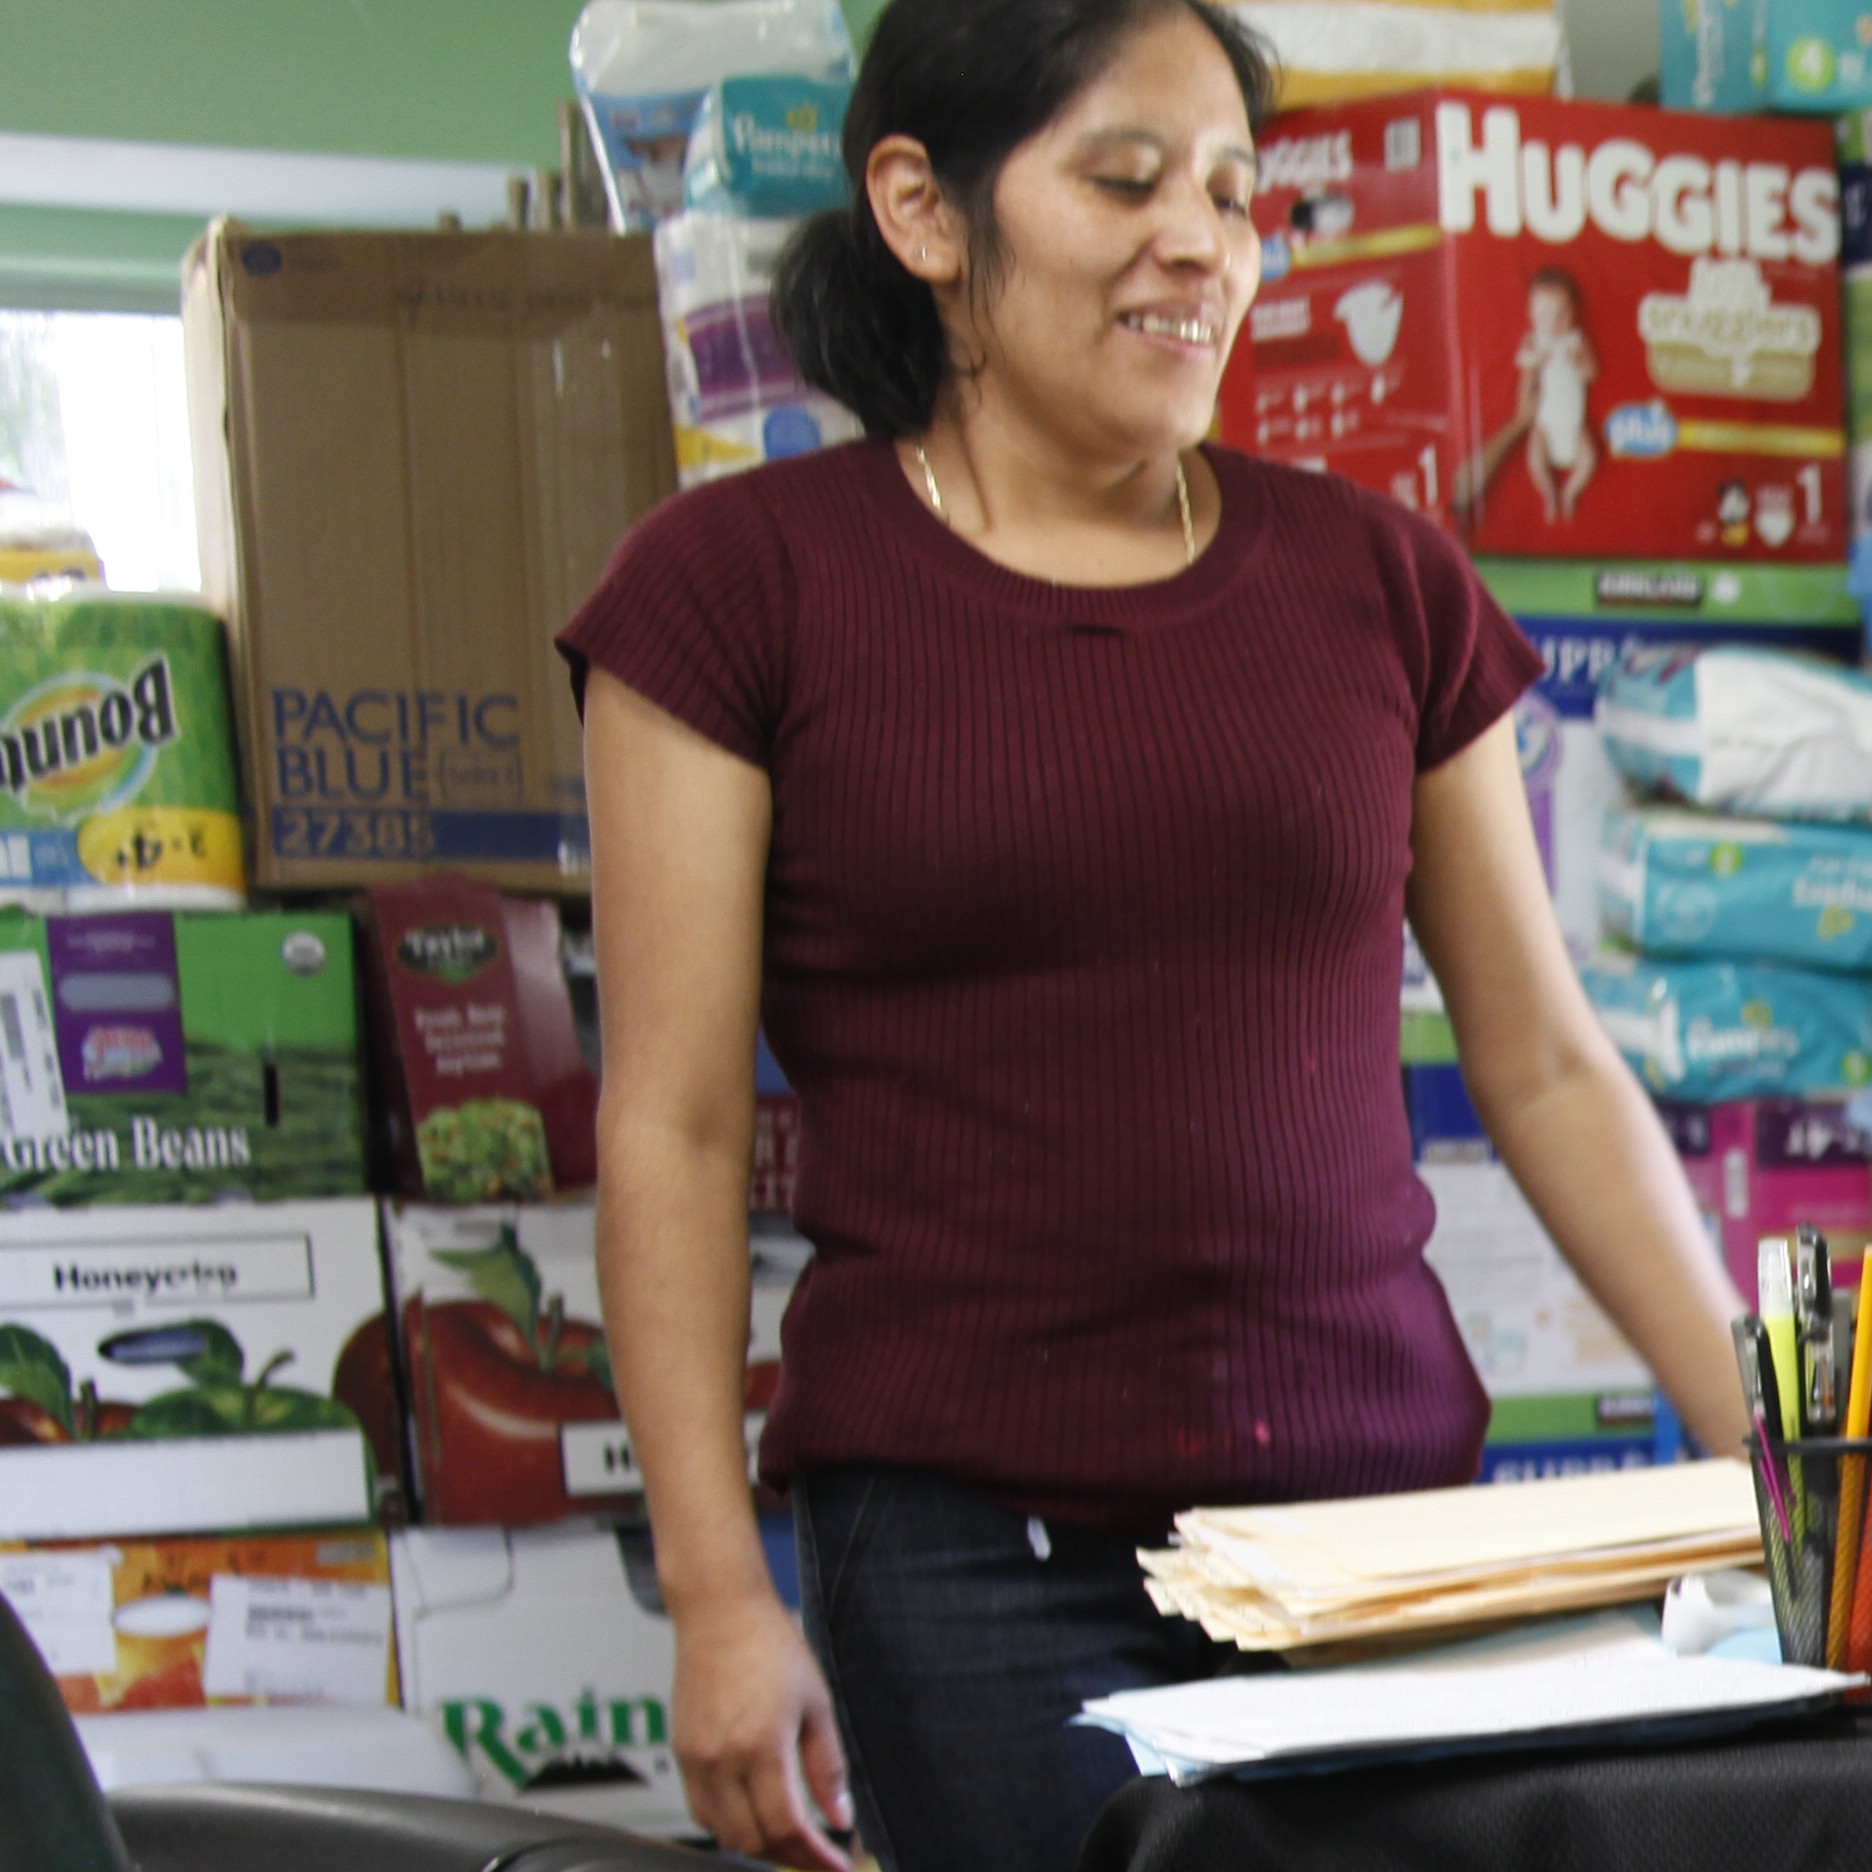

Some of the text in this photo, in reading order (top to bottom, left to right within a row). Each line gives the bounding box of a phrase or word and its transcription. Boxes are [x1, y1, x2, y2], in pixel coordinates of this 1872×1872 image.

[1435, 99, 1842, 265] HUGGIES
[0, 658, 178, 796] Bount
[273, 689, 520, 747] PACIFIC
[279, 748, 431, 798] BLUE
[131, 1116, 252, 1170] Beans
